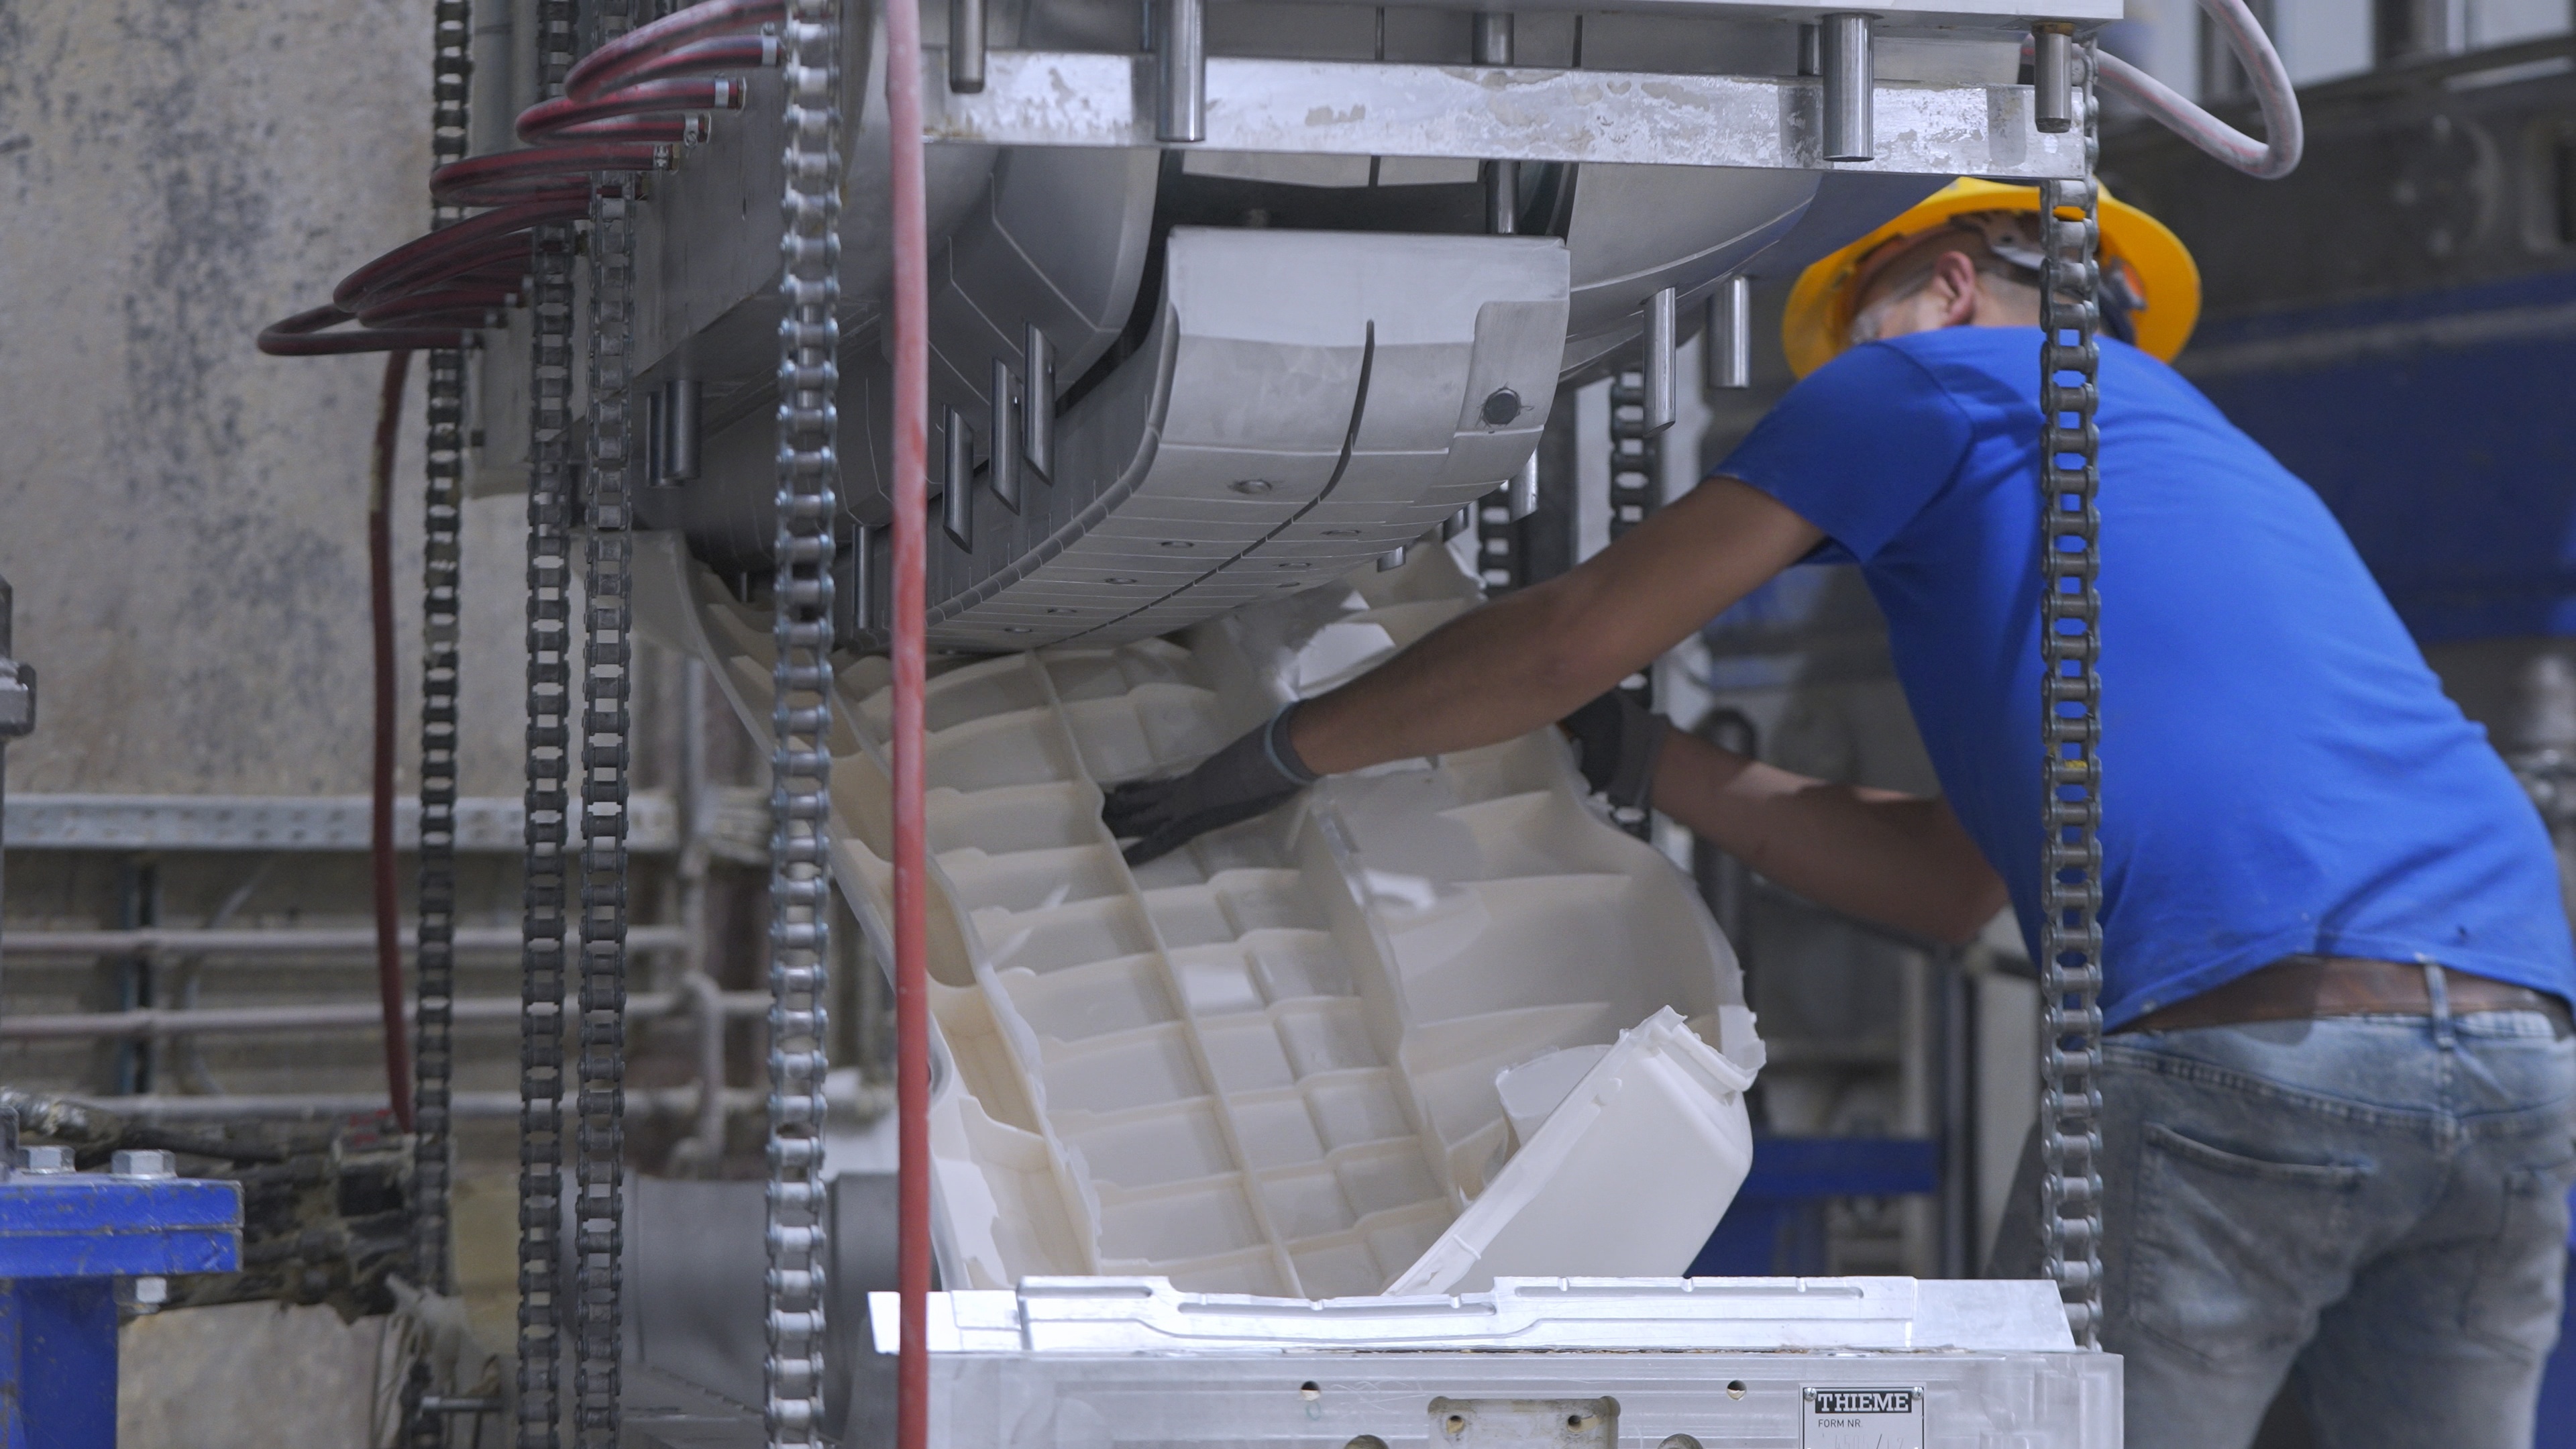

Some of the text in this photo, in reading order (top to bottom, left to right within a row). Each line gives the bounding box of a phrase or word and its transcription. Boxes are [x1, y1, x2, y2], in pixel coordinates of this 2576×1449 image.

[1818, 1393, 1909, 1411] THIEME
[1818, 1419, 1863, 1428] FORM NR.
